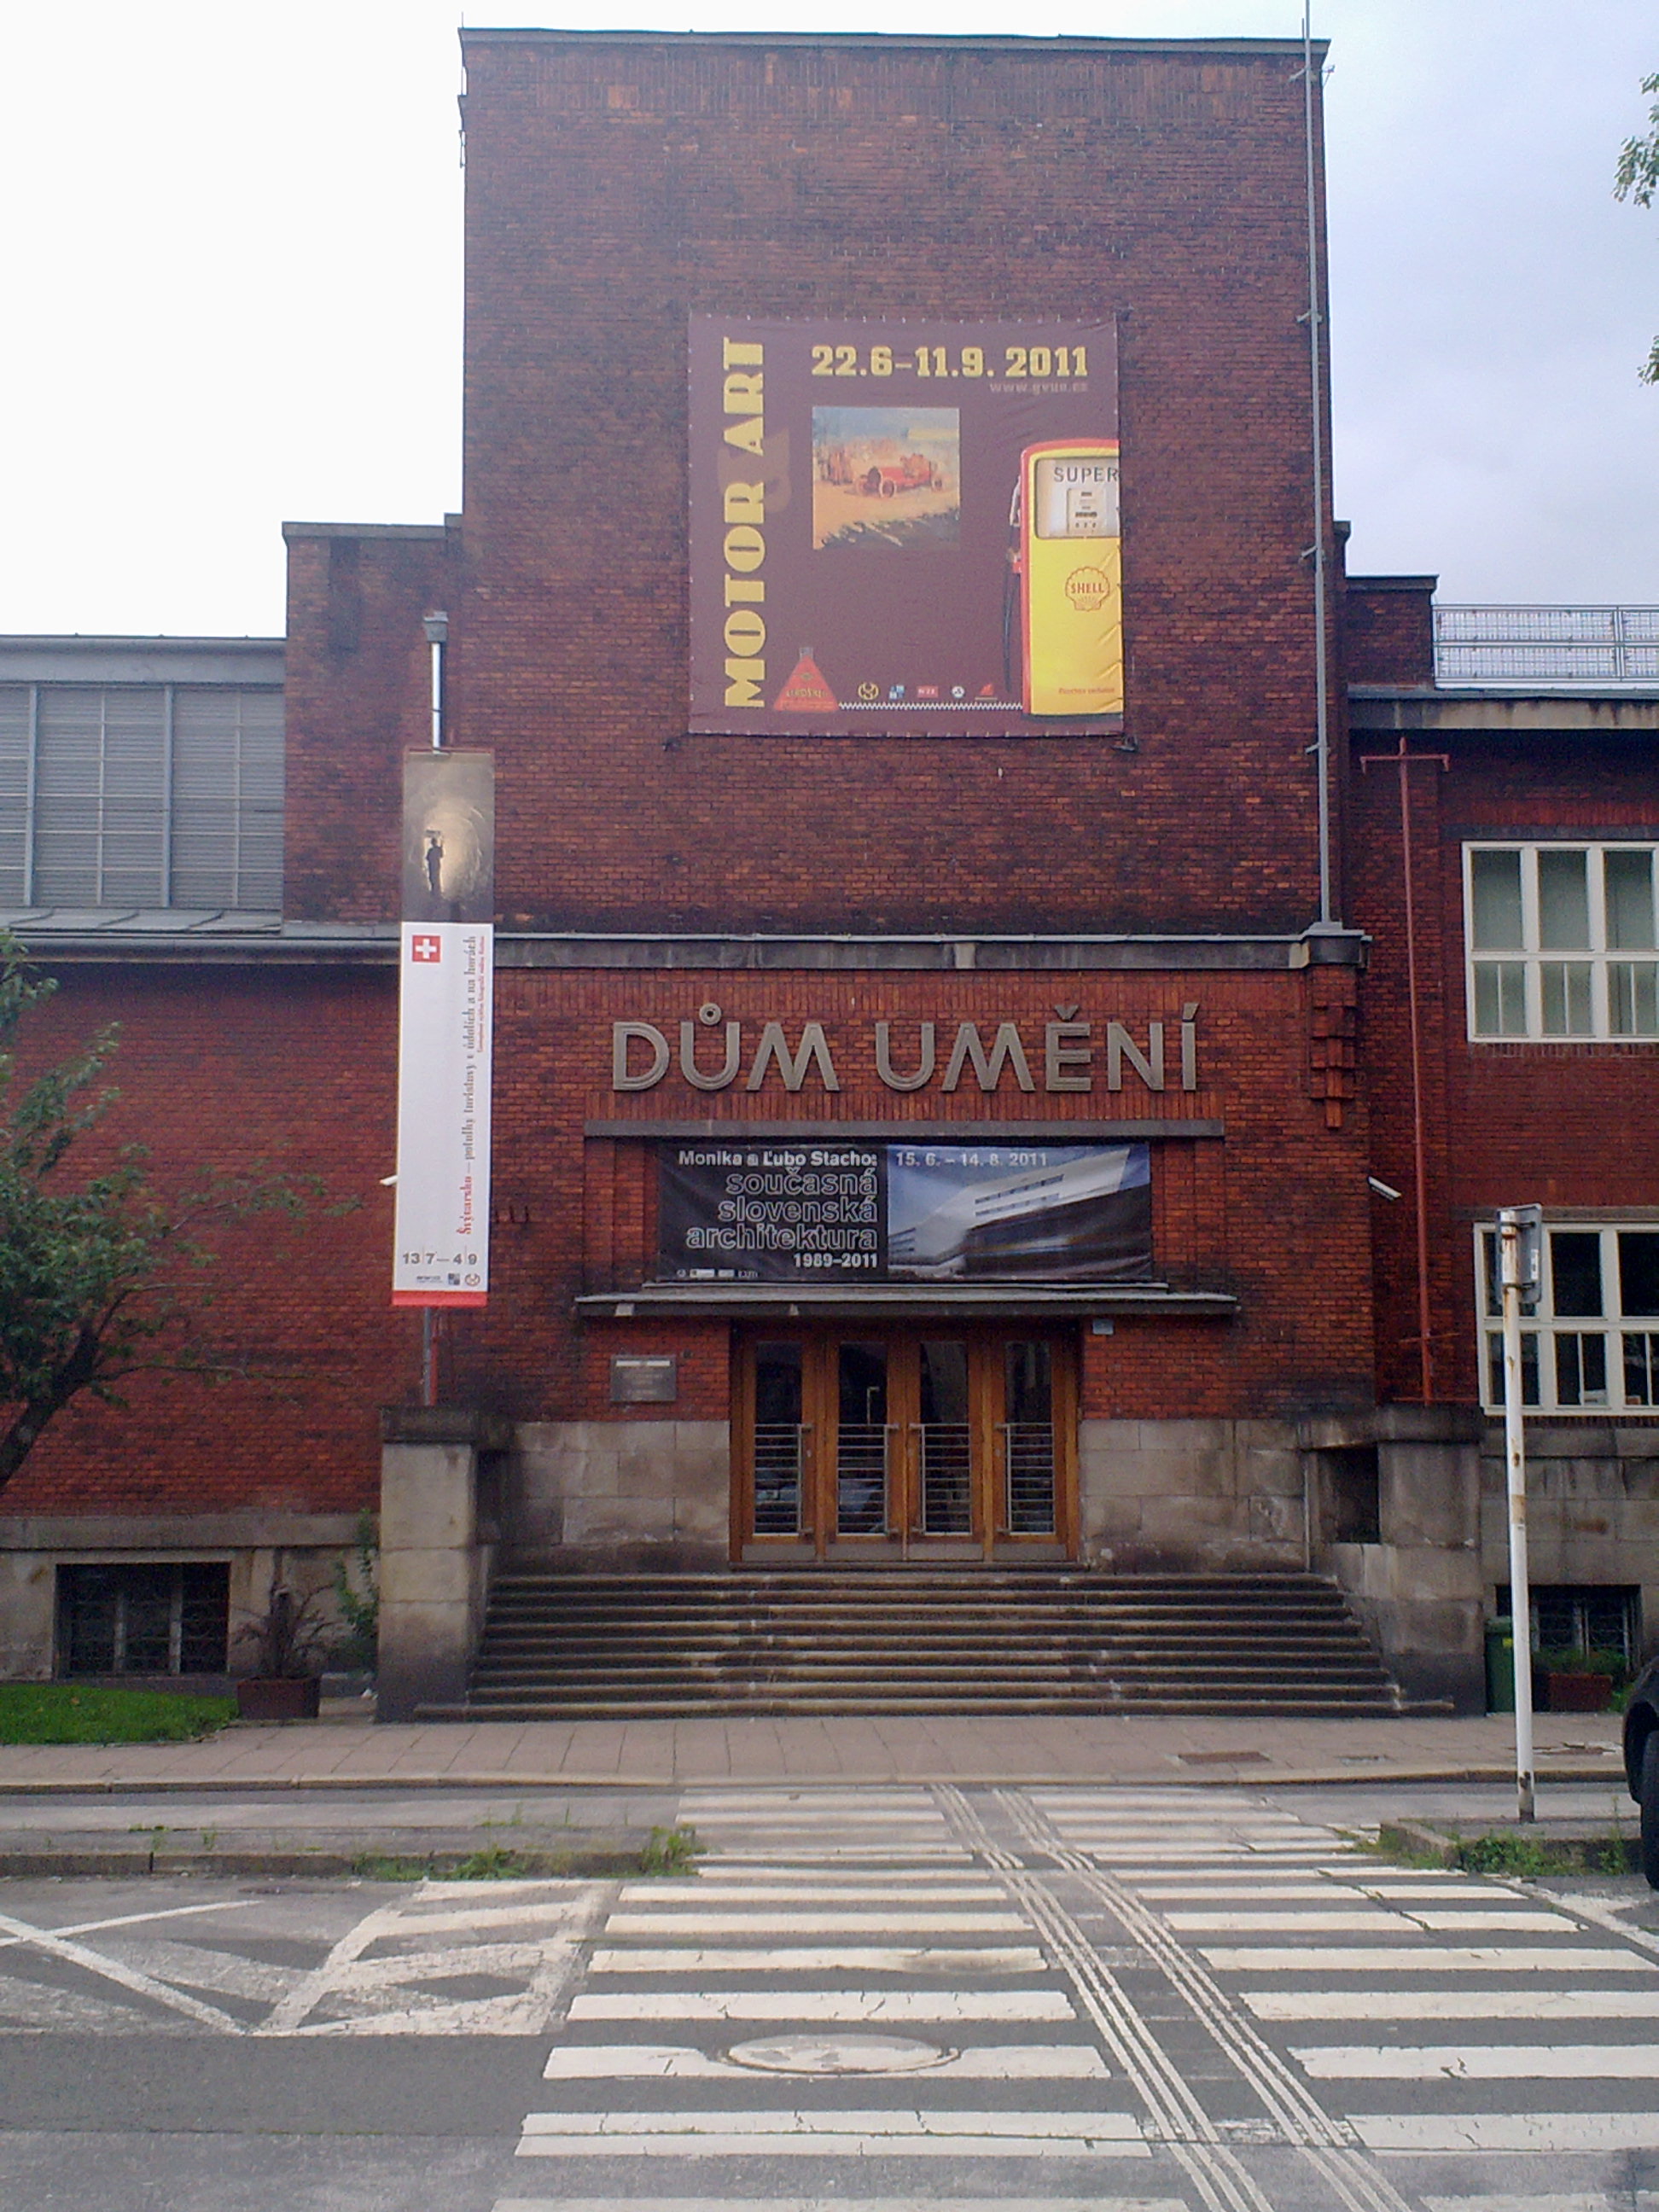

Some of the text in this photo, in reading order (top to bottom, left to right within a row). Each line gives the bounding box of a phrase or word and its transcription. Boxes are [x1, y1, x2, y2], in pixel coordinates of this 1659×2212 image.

[1006, 346, 1089, 377] 2011
[1053, 466, 1120, 483] SUPER
[723, 336, 766, 707] MOTOR ART
[1070, 582, 1105, 594] SHELL
[612, 1002, 1200, 1092] DŮM UMĚNÍ
[678, 1150, 742, 1166] Monika
[747, 1153, 759, 1166] a
[810, 1150, 878, 1166] Stacho:
[1009, 1153, 1048, 1167] 2011
[725, 1167, 878, 1196] současná
[718, 1196, 878, 1223] slovenská
[685, 1223, 878, 1250] architektura
